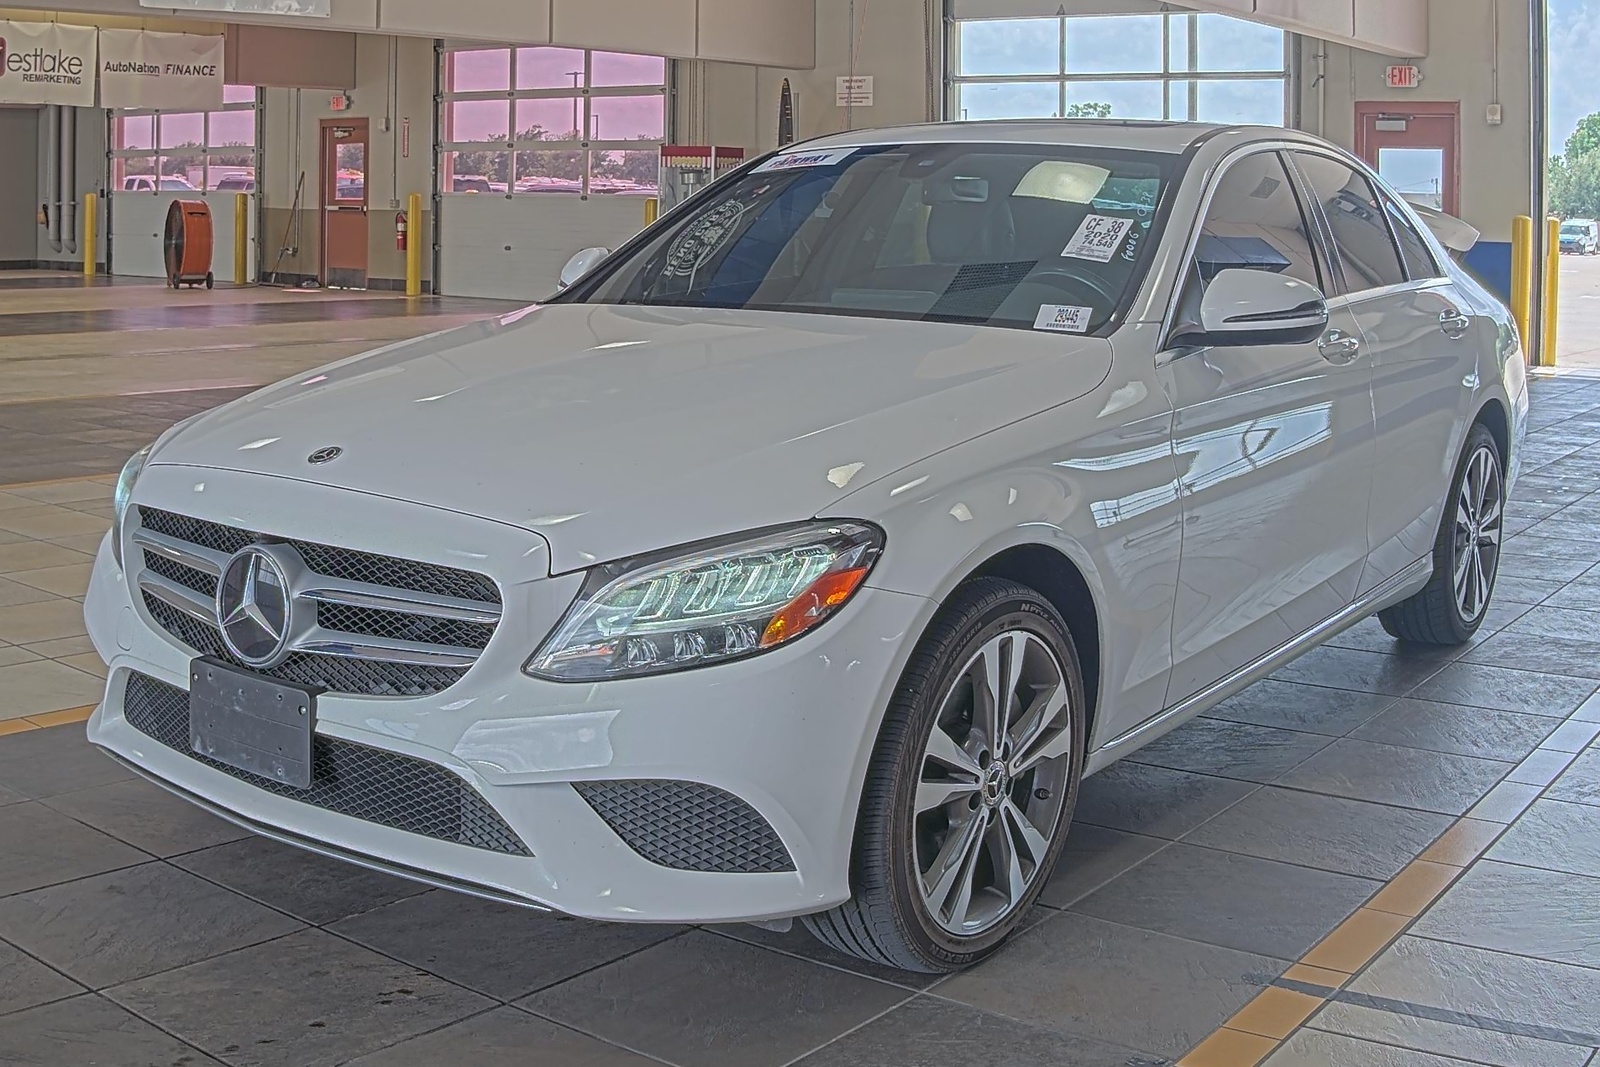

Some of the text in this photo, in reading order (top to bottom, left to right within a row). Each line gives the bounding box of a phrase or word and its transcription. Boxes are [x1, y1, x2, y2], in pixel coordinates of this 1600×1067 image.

[0, 47, 82, 75] estlake
[104, 61, 217, 77] AutoNation FINANCE
[1391, 67, 1413, 86] EXIT
[1086, 218, 1125, 234] CF 38
[1084, 230, 1119, 241] 2020
[929, 943, 974, 963] NEXEN
